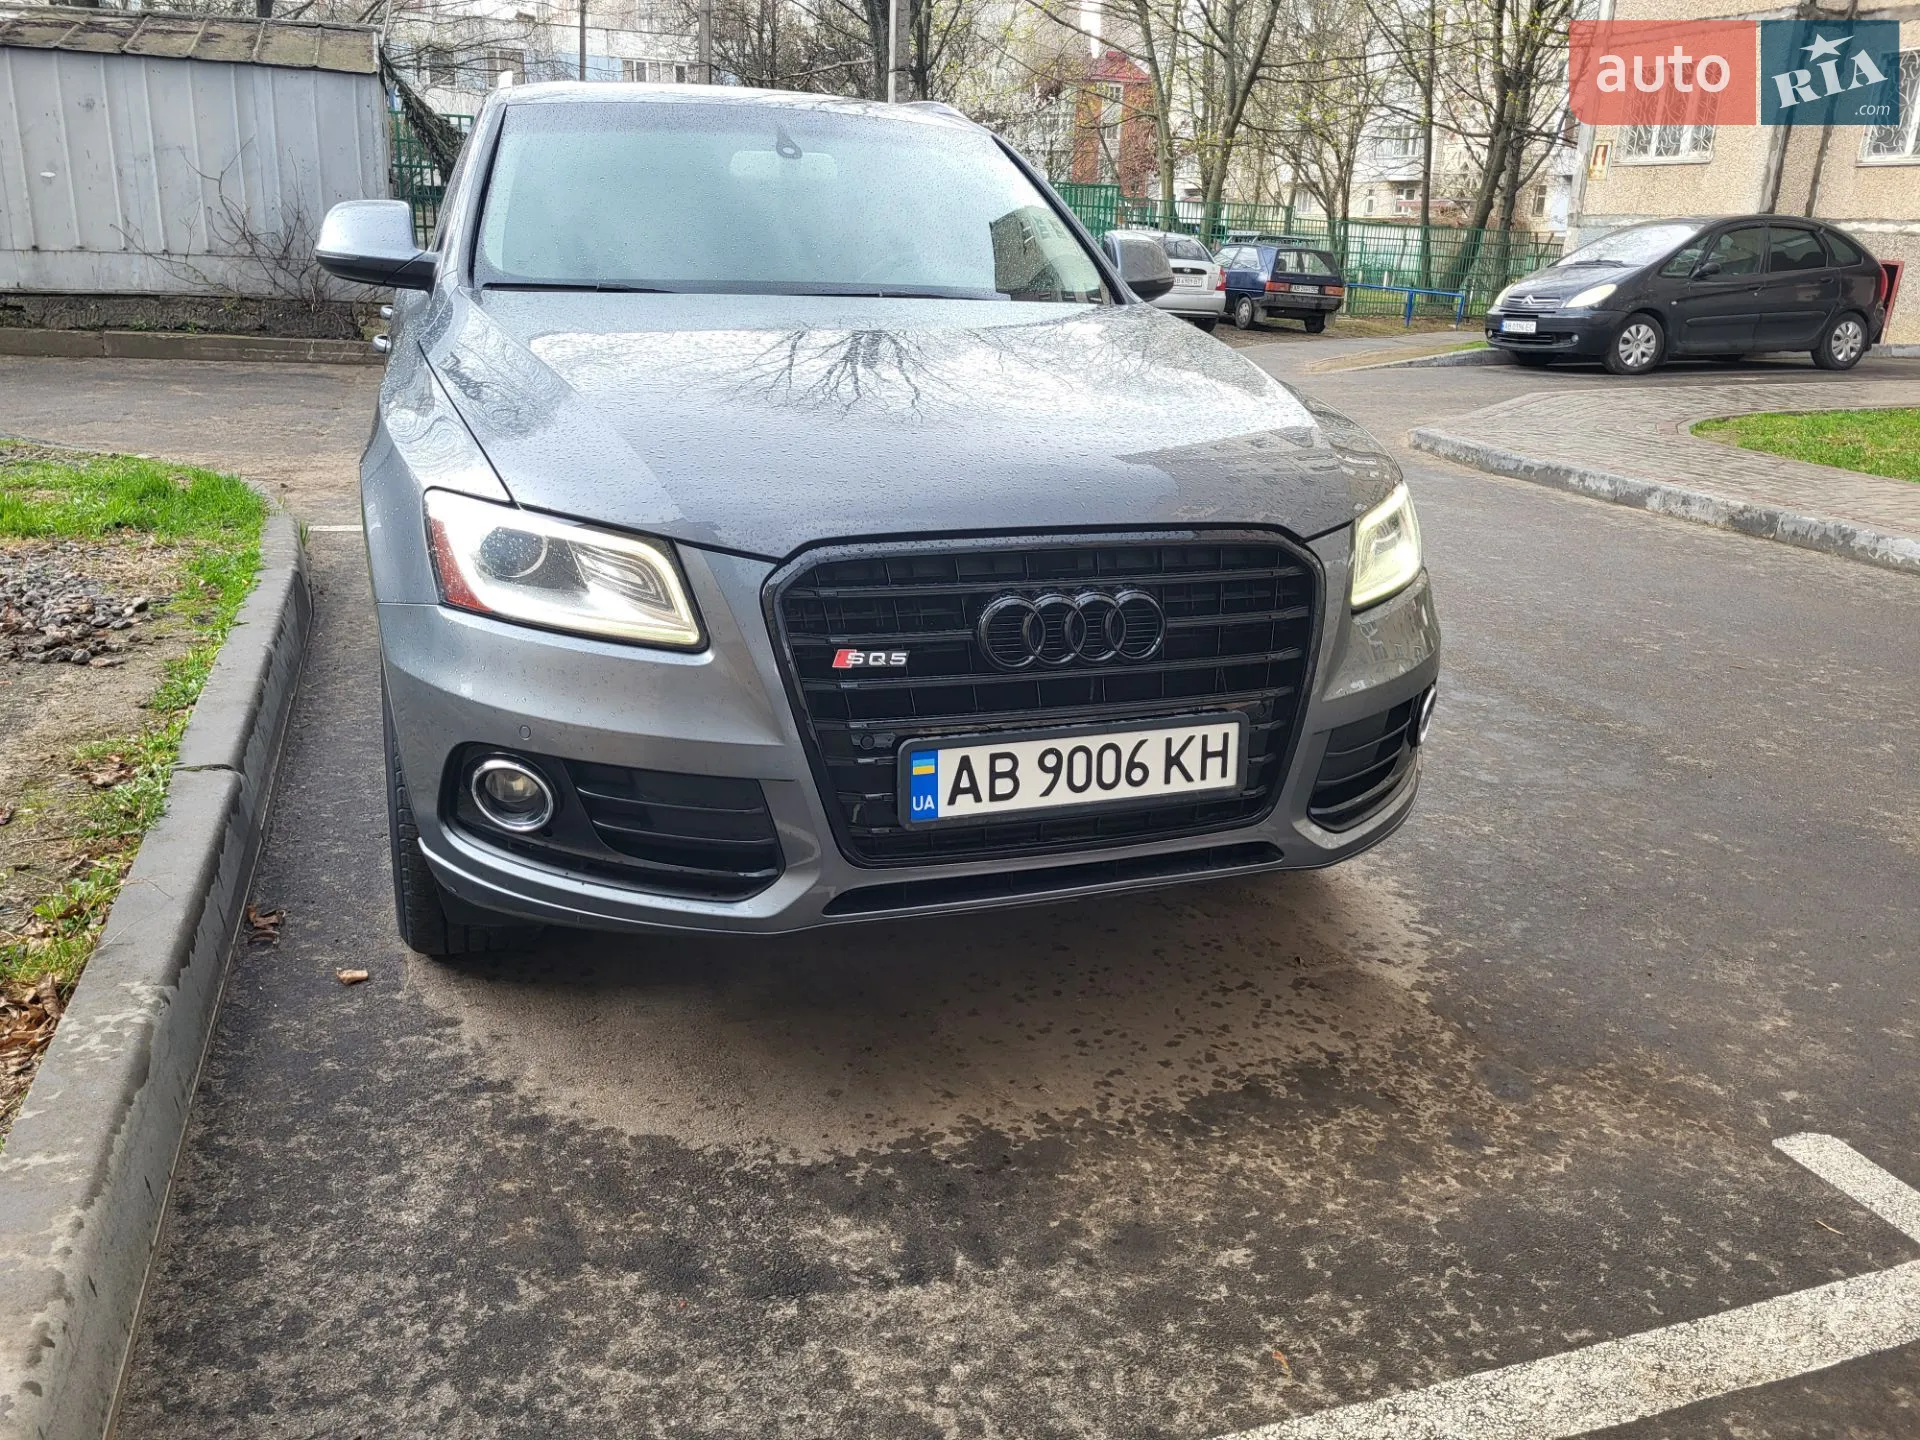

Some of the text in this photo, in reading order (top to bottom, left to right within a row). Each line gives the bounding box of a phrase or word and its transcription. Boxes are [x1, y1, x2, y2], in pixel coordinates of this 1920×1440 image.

[845, 652, 907, 666] SQ5
[947, 731, 1230, 807] AB 9006 KH
[912, 794, 935, 811] UA
